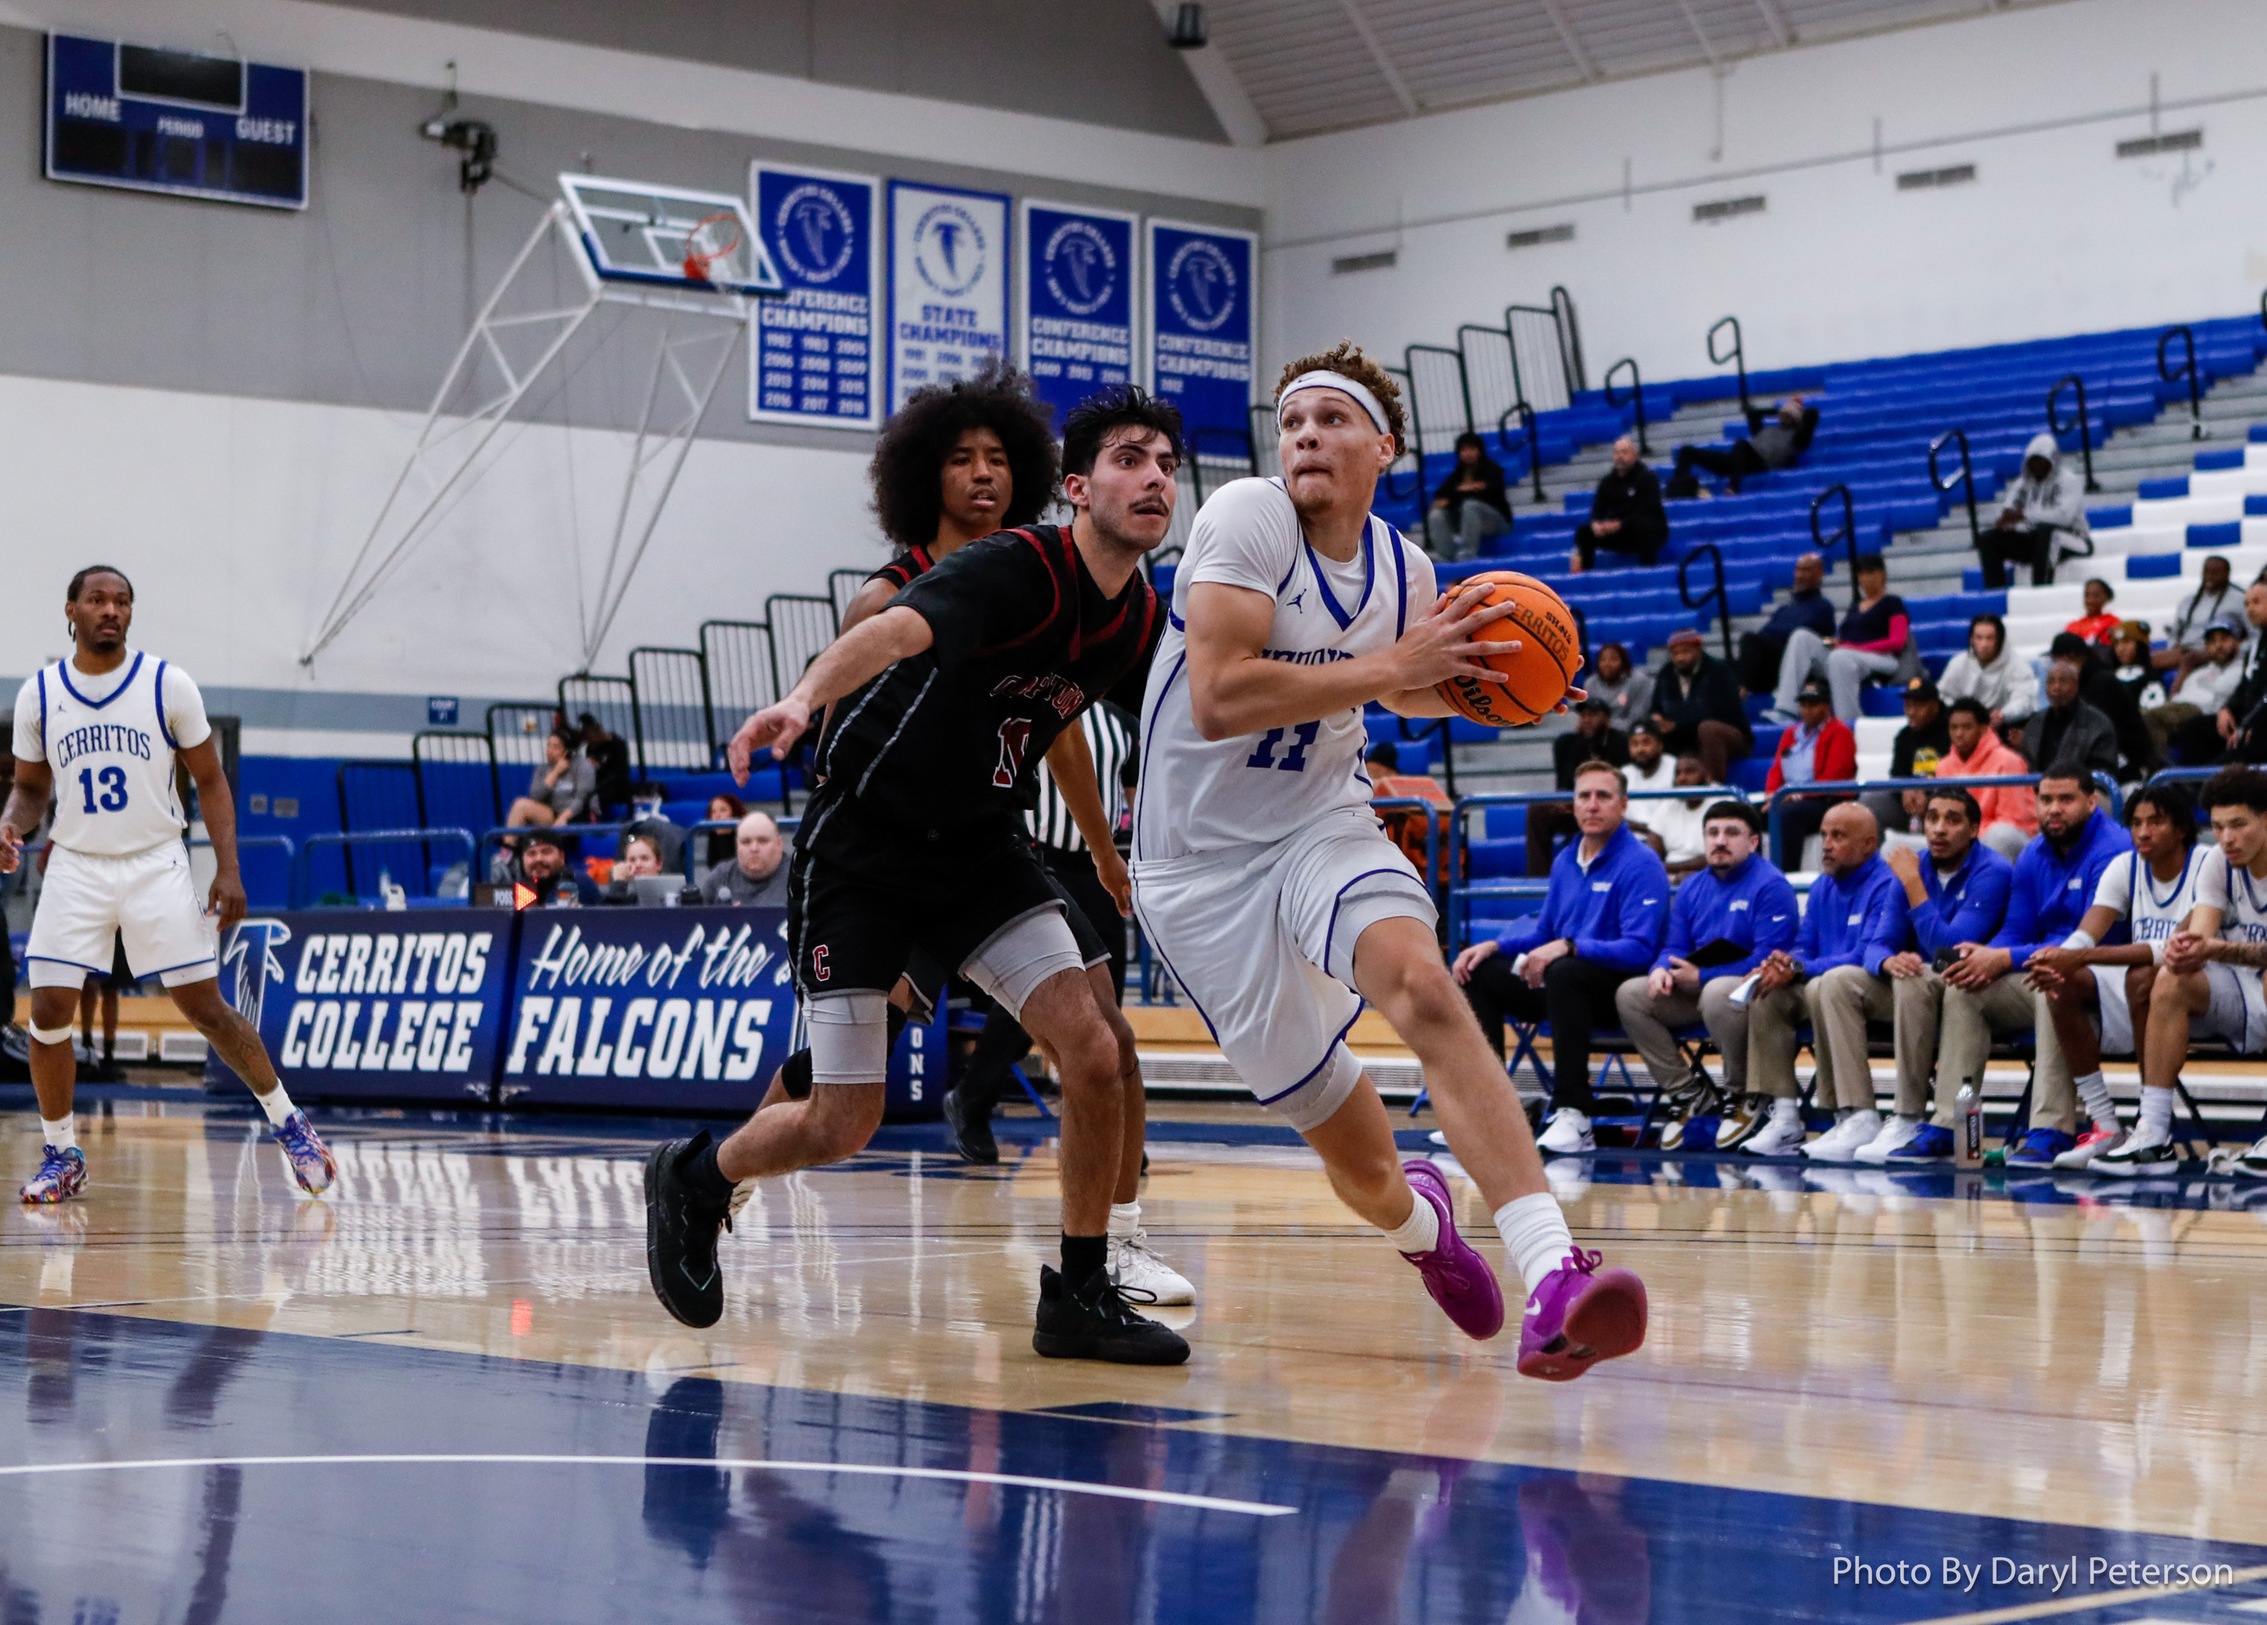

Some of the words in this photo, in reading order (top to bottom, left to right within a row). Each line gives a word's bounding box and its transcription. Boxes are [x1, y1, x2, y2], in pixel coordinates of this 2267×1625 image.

[64, 92, 121, 121] HOME
[157, 117, 204, 138] PERIOD
[236, 117, 296, 144] GUEST
[762, 306, 868, 336] CHAMPIONS
[922, 304, 977, 327] STATE
[1032, 316, 1129, 344] CONFERENCE
[900, 322, 1002, 350] CHAMPIONS
[1158, 333, 1248, 360] CONFERENCE
[1032, 337, 1129, 366] CHAMPIONS
[1158, 353, 1249, 381] CHAMPIONS
[57, 725, 151, 769] CERRITOS
[79, 766, 128, 814] 13
[295, 932, 493, 994] CERRITOS
[529, 923, 651, 990] Home
[647, 923, 705, 990] of
[699, 923, 775, 990] the
[813, 944, 831, 982] C
[281, 1000, 484, 1072] COLLEGE
[505, 996, 772, 1080] FALCONS
